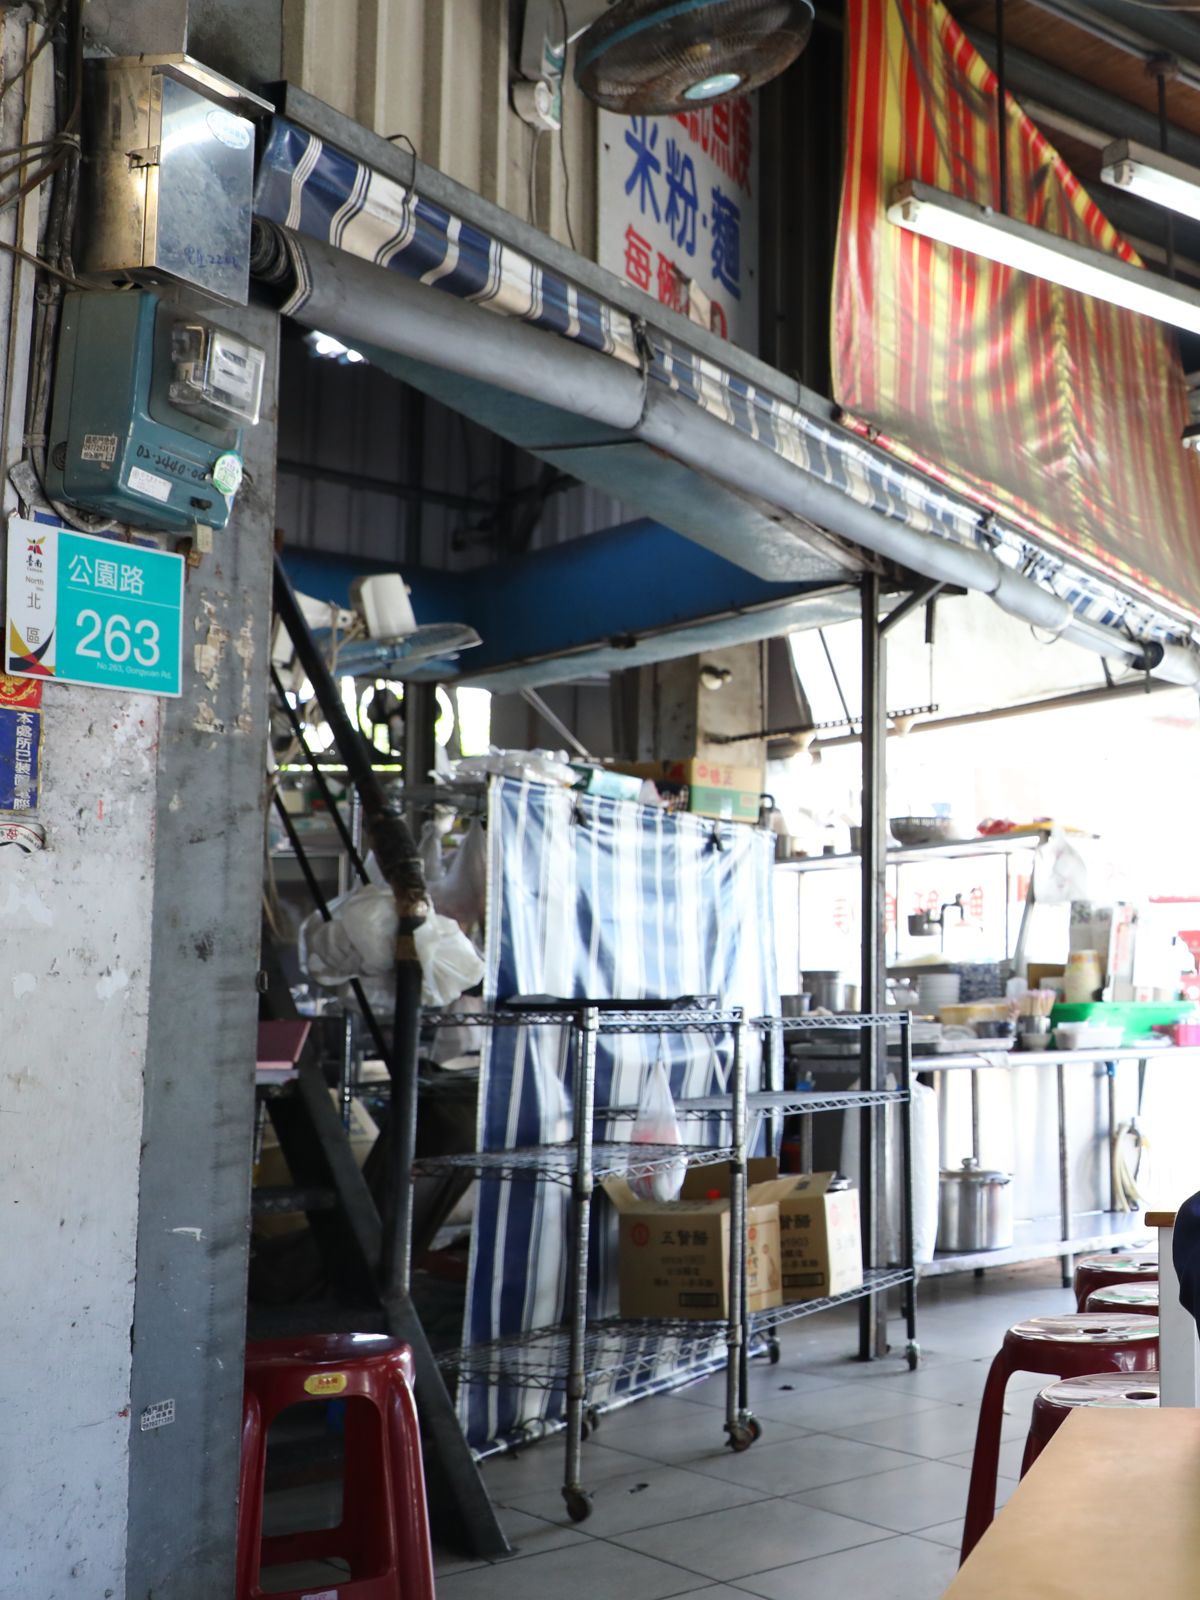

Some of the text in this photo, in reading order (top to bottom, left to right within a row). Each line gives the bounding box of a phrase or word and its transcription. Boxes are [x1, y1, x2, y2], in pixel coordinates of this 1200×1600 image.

[25, 575, 44, 586] North
[68, 554, 144, 596] 公園路
[75, 608, 160, 667] 263
